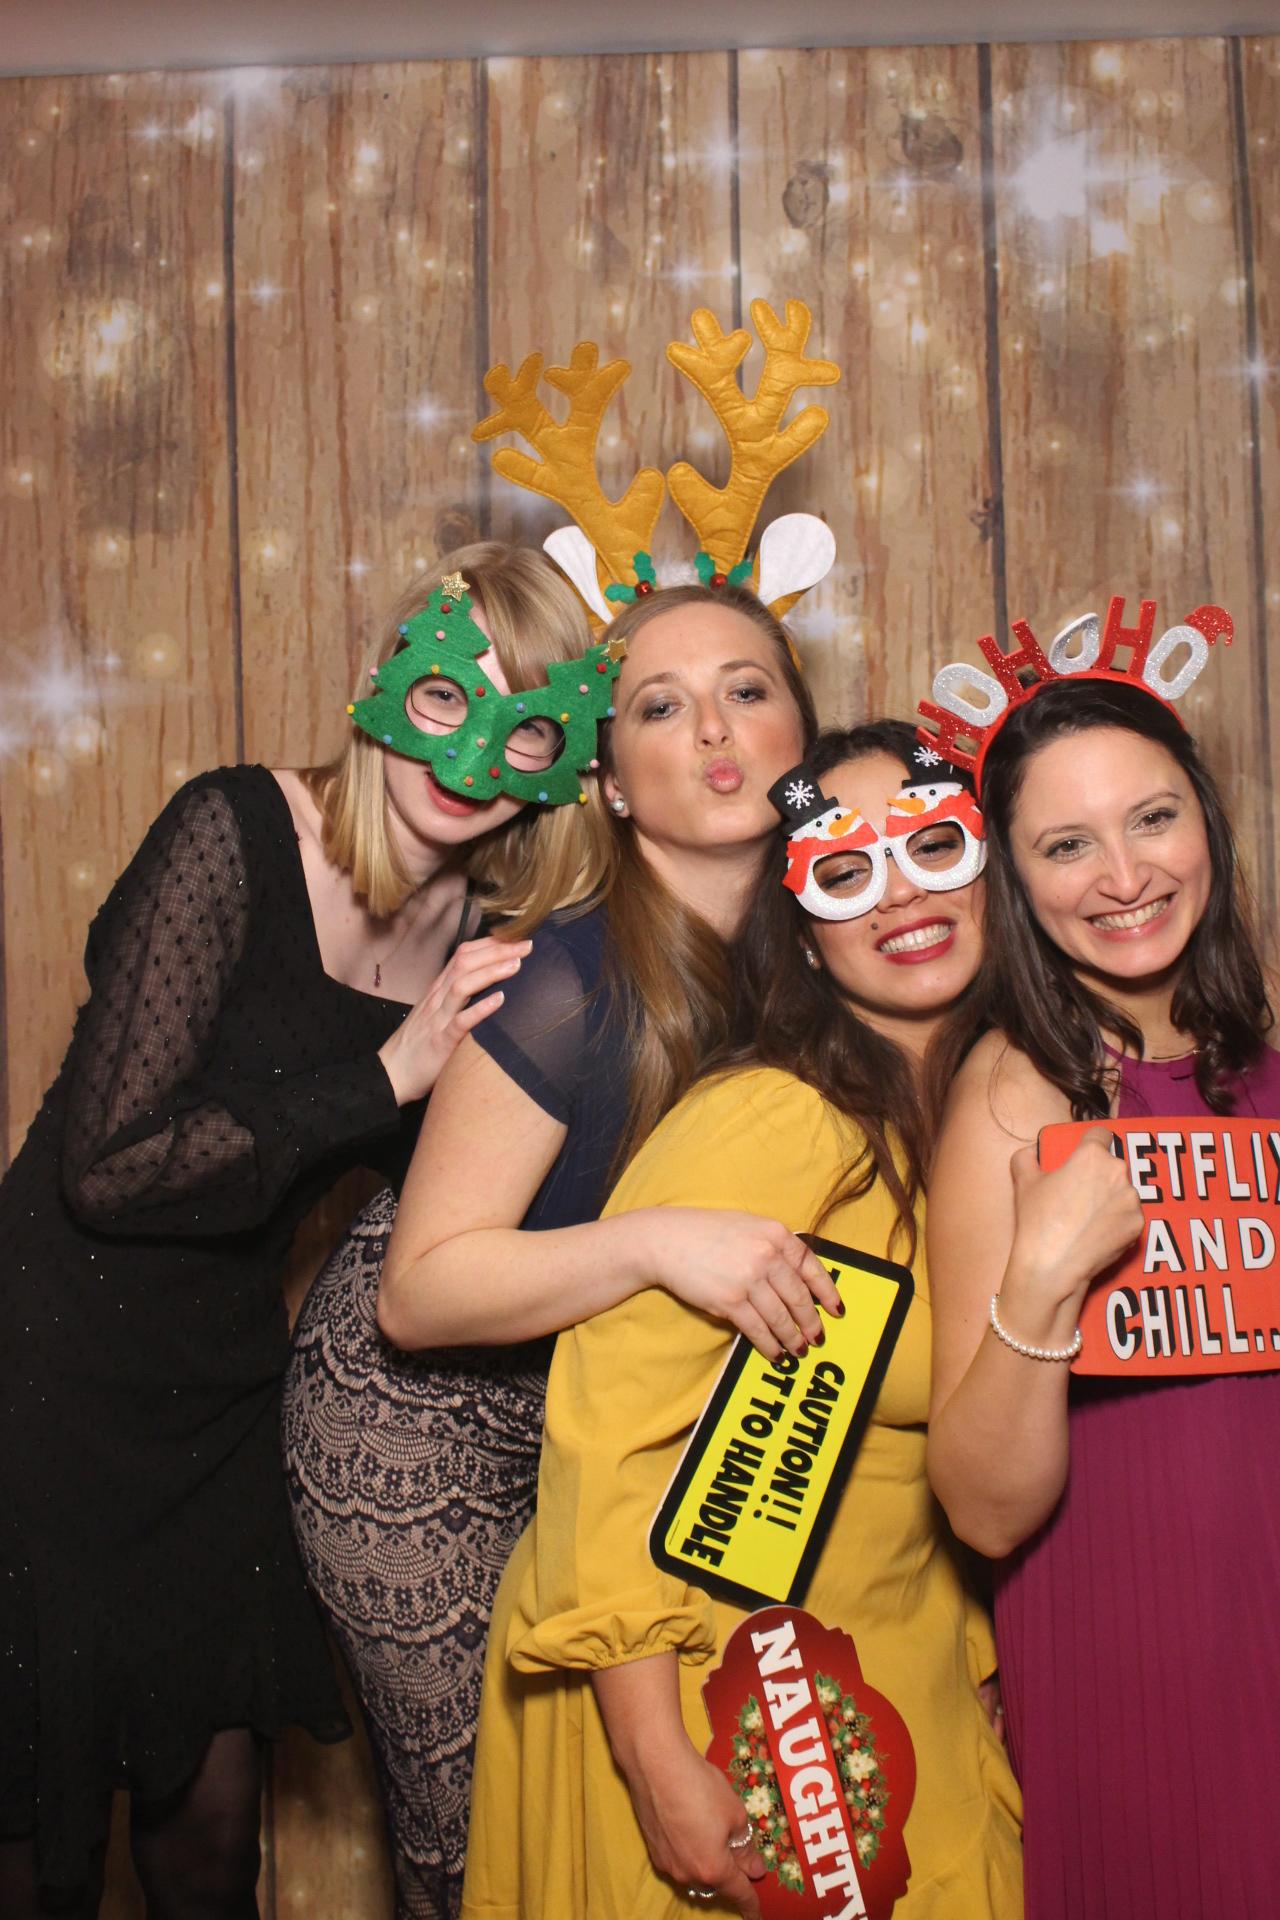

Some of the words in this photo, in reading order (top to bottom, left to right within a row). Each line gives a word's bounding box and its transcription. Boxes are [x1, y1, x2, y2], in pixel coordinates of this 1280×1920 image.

[1111, 1132, 1280, 1204] ETFLI
[1143, 1217, 1276, 1273] AND
[761, 1349, 799, 1397] OT
[741, 1397, 785, 1439] TO
[752, 1361, 845, 1532] CAUTION!!
[680, 1438, 766, 1568] HANDLE
